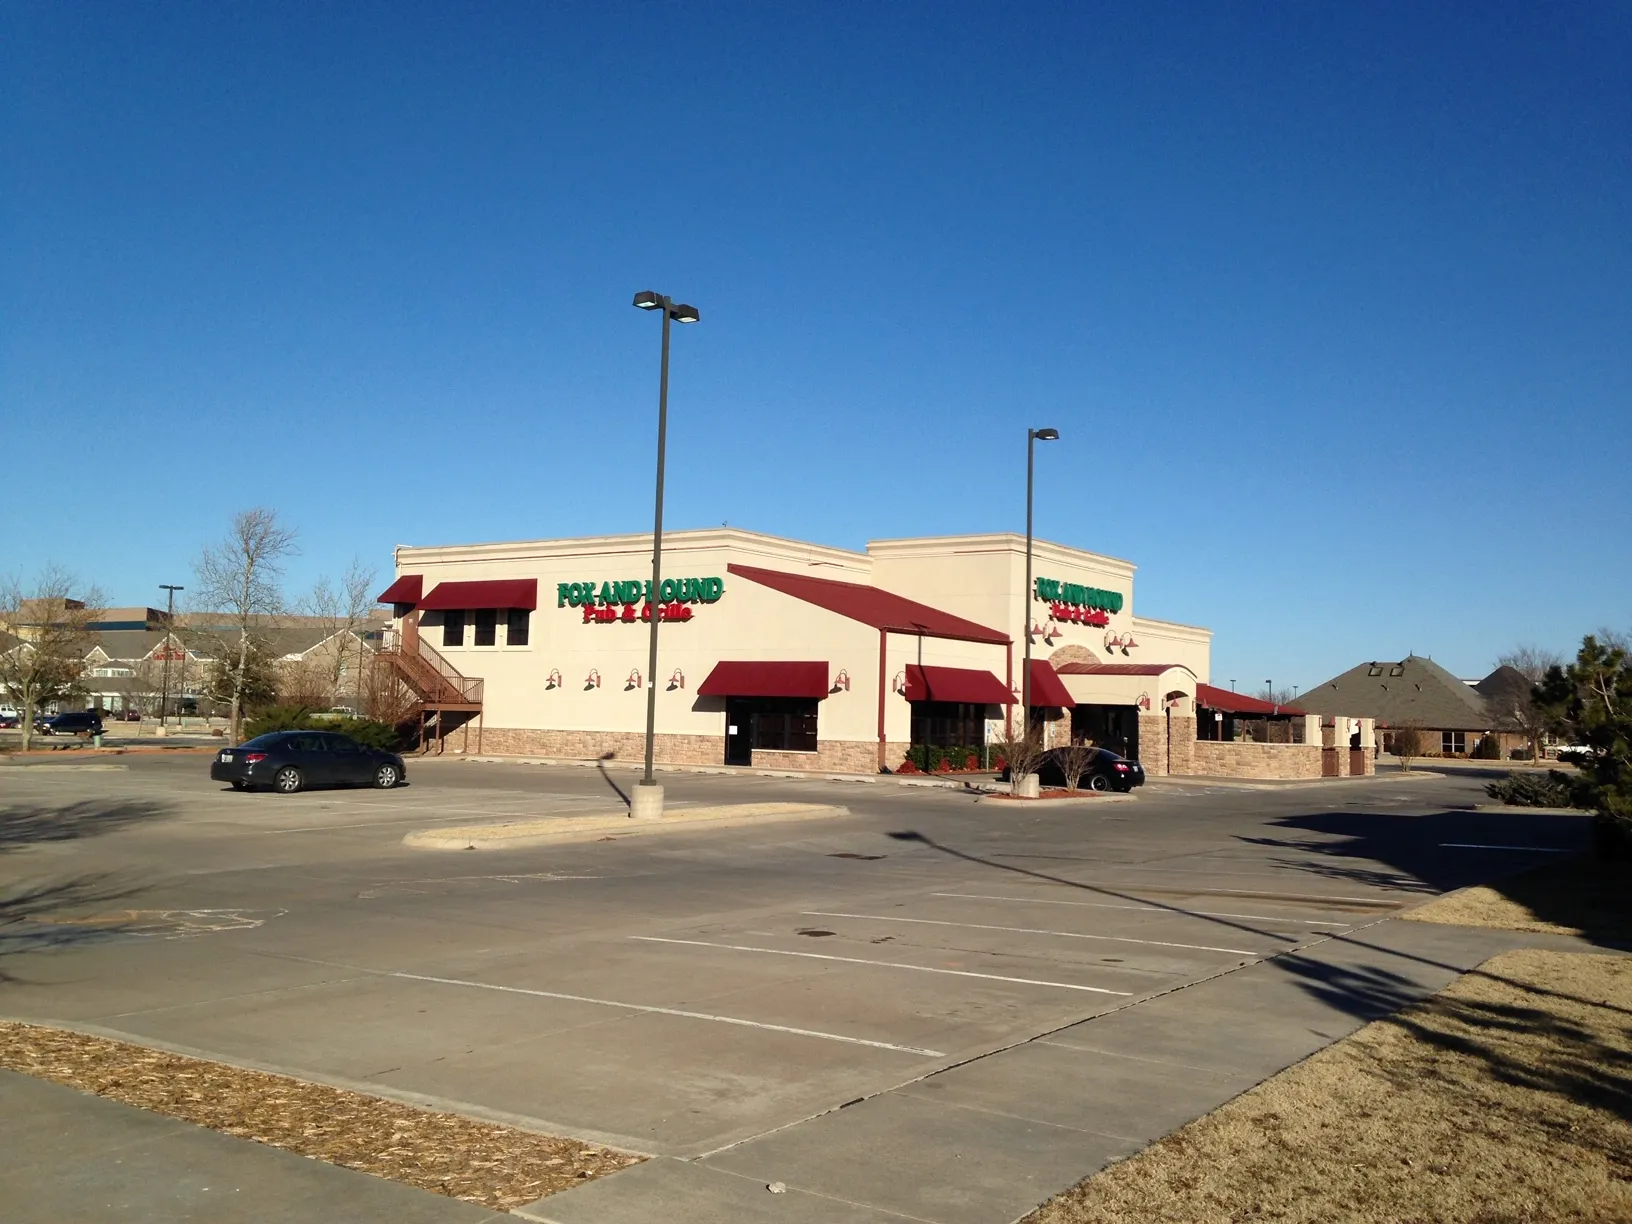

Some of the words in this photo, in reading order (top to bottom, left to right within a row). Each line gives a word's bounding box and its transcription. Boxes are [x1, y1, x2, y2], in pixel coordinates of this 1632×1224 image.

[557, 582, 596, 606] FOX
[599, 580, 643, 605] AND
[584, 603, 617, 621] Pub
[622, 604, 636, 620] &
[641, 602, 692, 620] Grille
